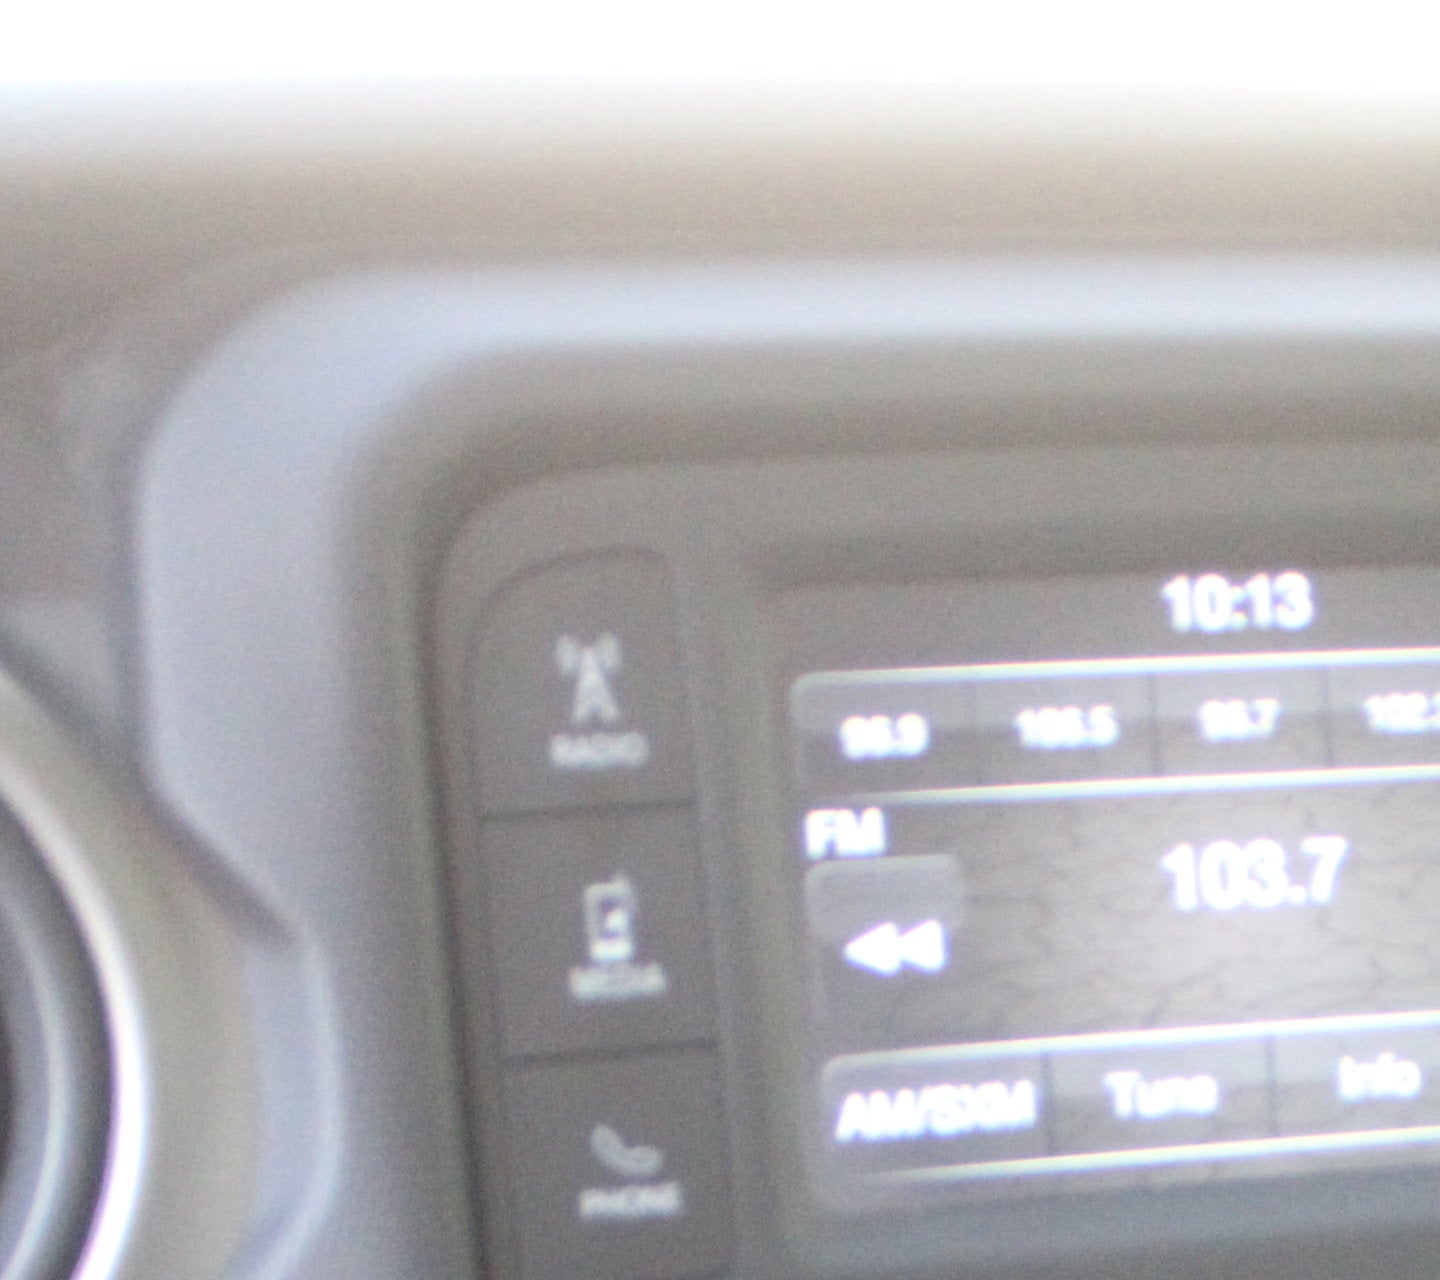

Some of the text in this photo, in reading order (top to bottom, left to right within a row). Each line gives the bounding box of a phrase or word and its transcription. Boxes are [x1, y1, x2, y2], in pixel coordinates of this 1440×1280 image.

[1160, 570, 1316, 634] 10:13
[803, 805, 888, 860] FM
[1159, 834, 1349, 914] 103.7
[1103, 1070, 1222, 1120] Tune
